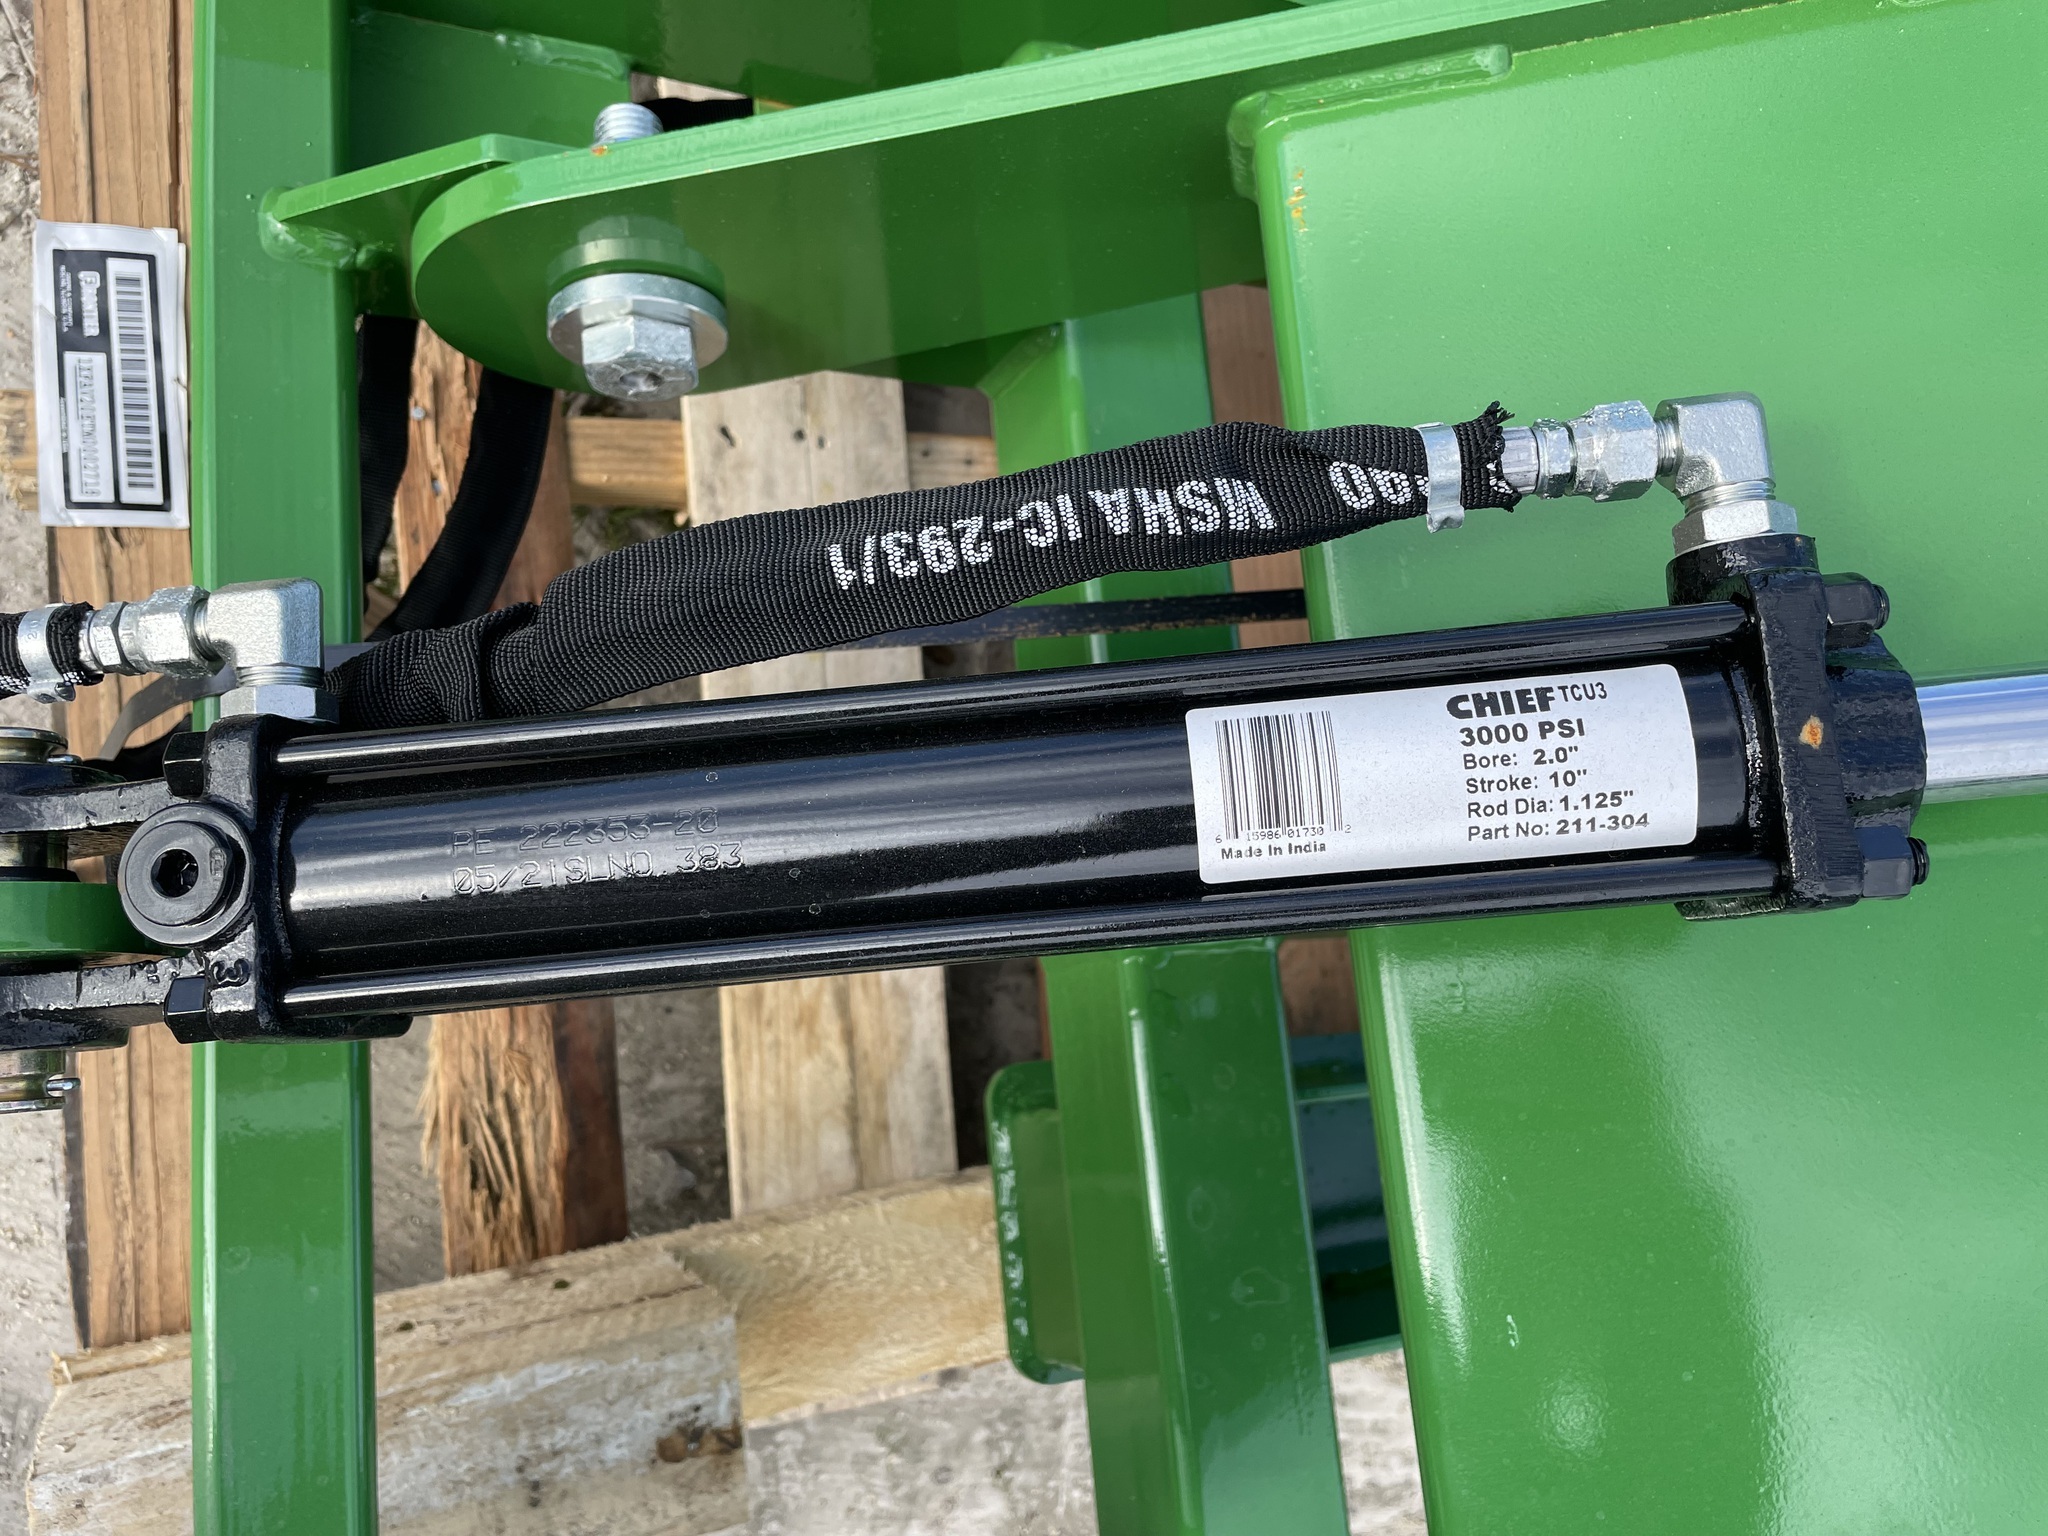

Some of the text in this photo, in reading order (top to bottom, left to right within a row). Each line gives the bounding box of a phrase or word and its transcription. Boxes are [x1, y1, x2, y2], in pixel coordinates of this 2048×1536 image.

[827, 477, 1275, 590] MSHA IC-293/1
[1446, 681, 1608, 719] CHIEF TCU3
[1459, 718, 1586, 747] 3000 PSI
[1463, 745, 1579, 770] Bore: 2.0"
[1465, 768, 1588, 794] Stroke: 10"
[1467, 790, 1634, 818] Rod Dia: 1.125"
[452, 807, 719, 857] PE 222353-20
[1215, 834, 1223, 844] 6
[1344, 824, 1352, 834] 2
[1468, 813, 1650, 842] Part No: 211-304
[676, 841, 745, 873] 383
[1221, 841, 1326, 860] Made In India
